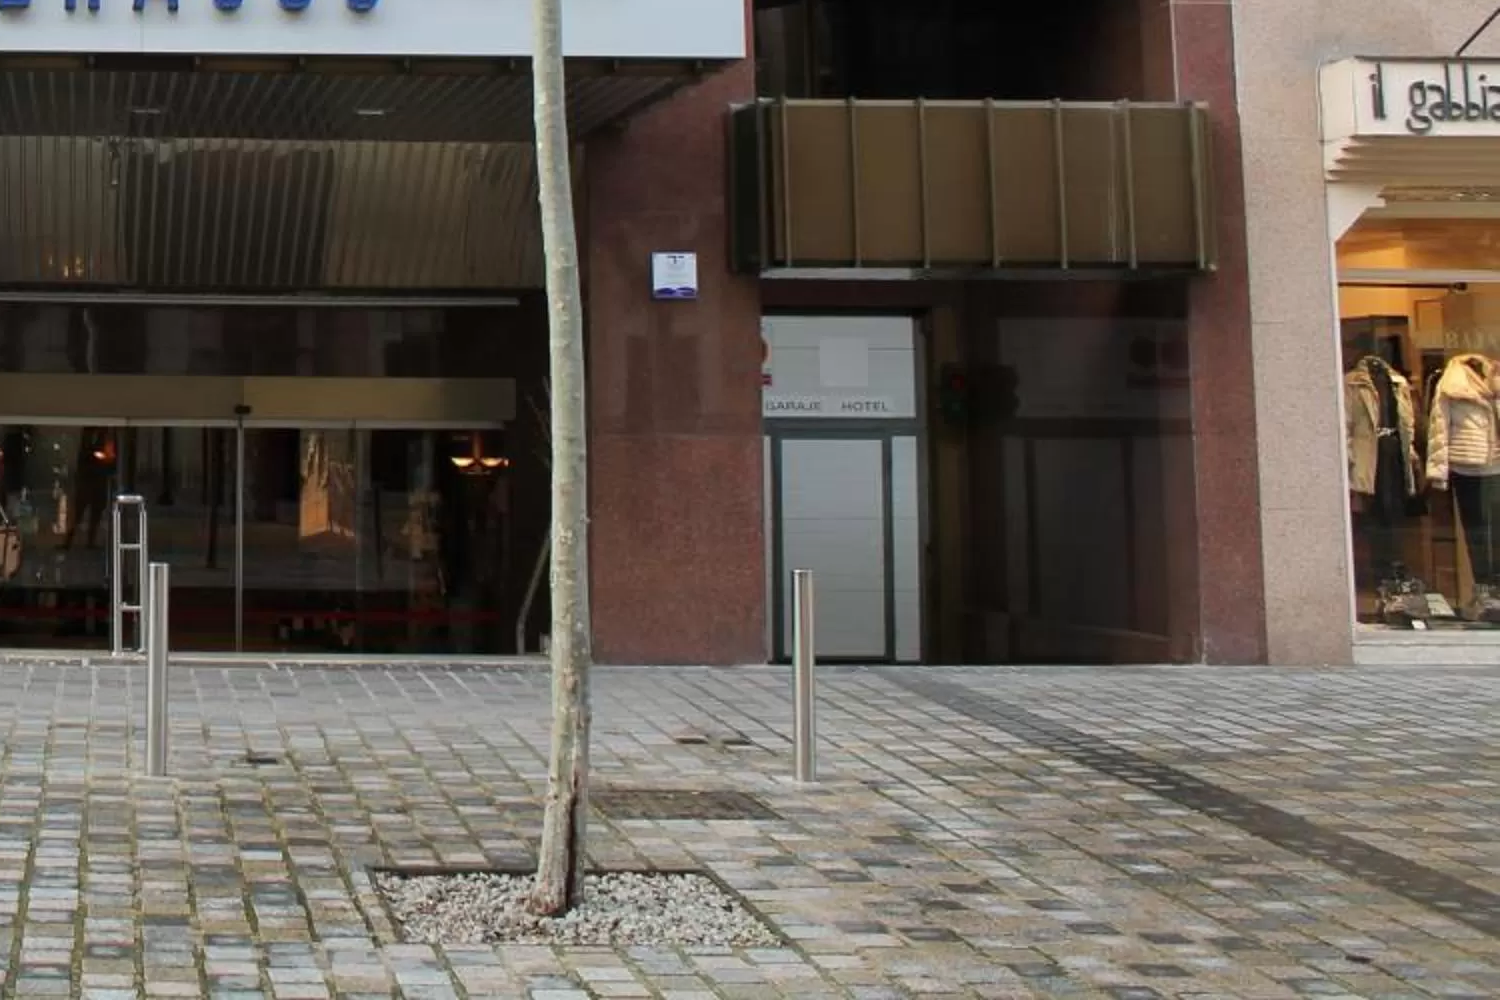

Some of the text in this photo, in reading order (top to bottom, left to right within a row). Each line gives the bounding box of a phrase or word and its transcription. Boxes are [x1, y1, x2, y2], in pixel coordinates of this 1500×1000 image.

[1369, 62, 1387, 120] il
[765, 400, 889, 413] GARAJE HOTEL
